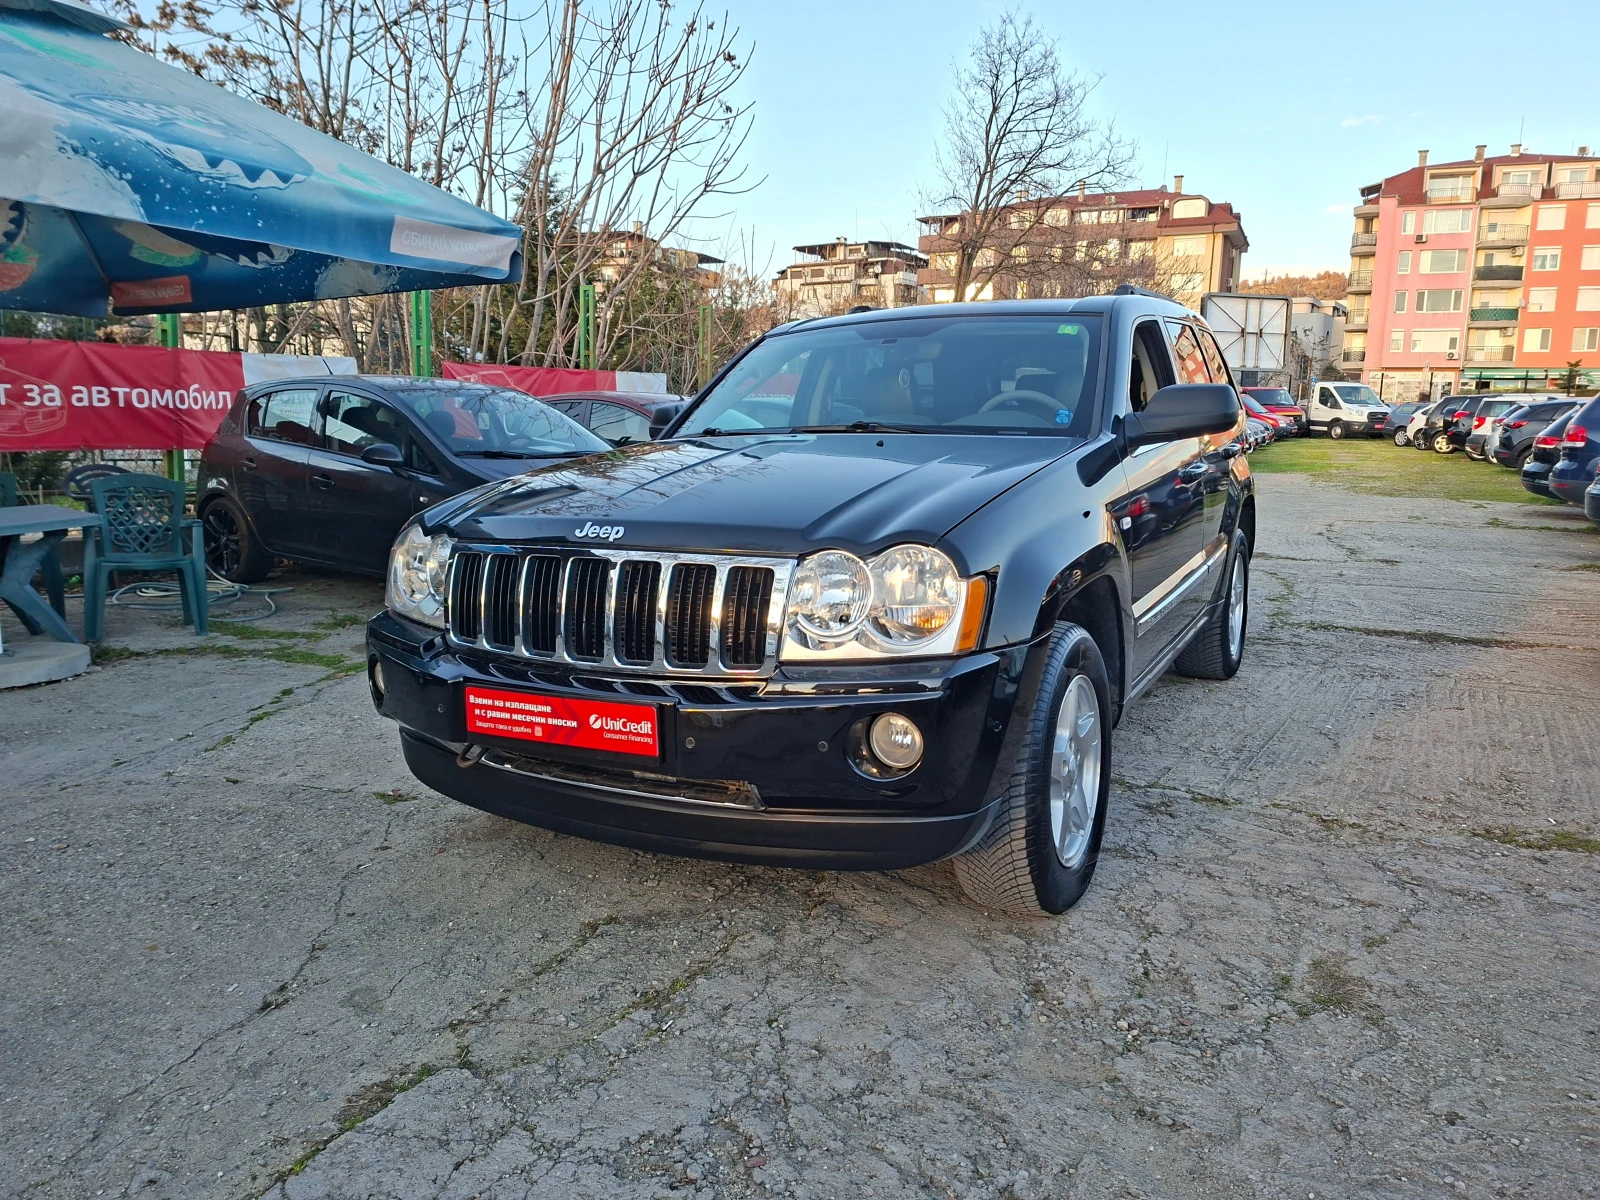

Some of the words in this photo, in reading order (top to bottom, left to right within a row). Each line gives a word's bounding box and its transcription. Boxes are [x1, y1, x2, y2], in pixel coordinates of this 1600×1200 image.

[402, 230, 448, 252] ОБИЧАЙ
[24, 384, 61, 406] за
[71, 384, 232, 409] автомобил
[574, 521, 625, 542] Jeep
[469, 695, 492, 705] Вземи
[494, 699, 503, 707] на
[505, 701, 552, 712] изплащане
[487, 710, 510, 720] равни
[512, 713, 545, 724] месечни
[547, 717, 577, 728] вноски
[602, 716, 652, 734] UniCredit
[603, 732, 628, 741] Consumer
[628, 735, 653, 745] Financing
